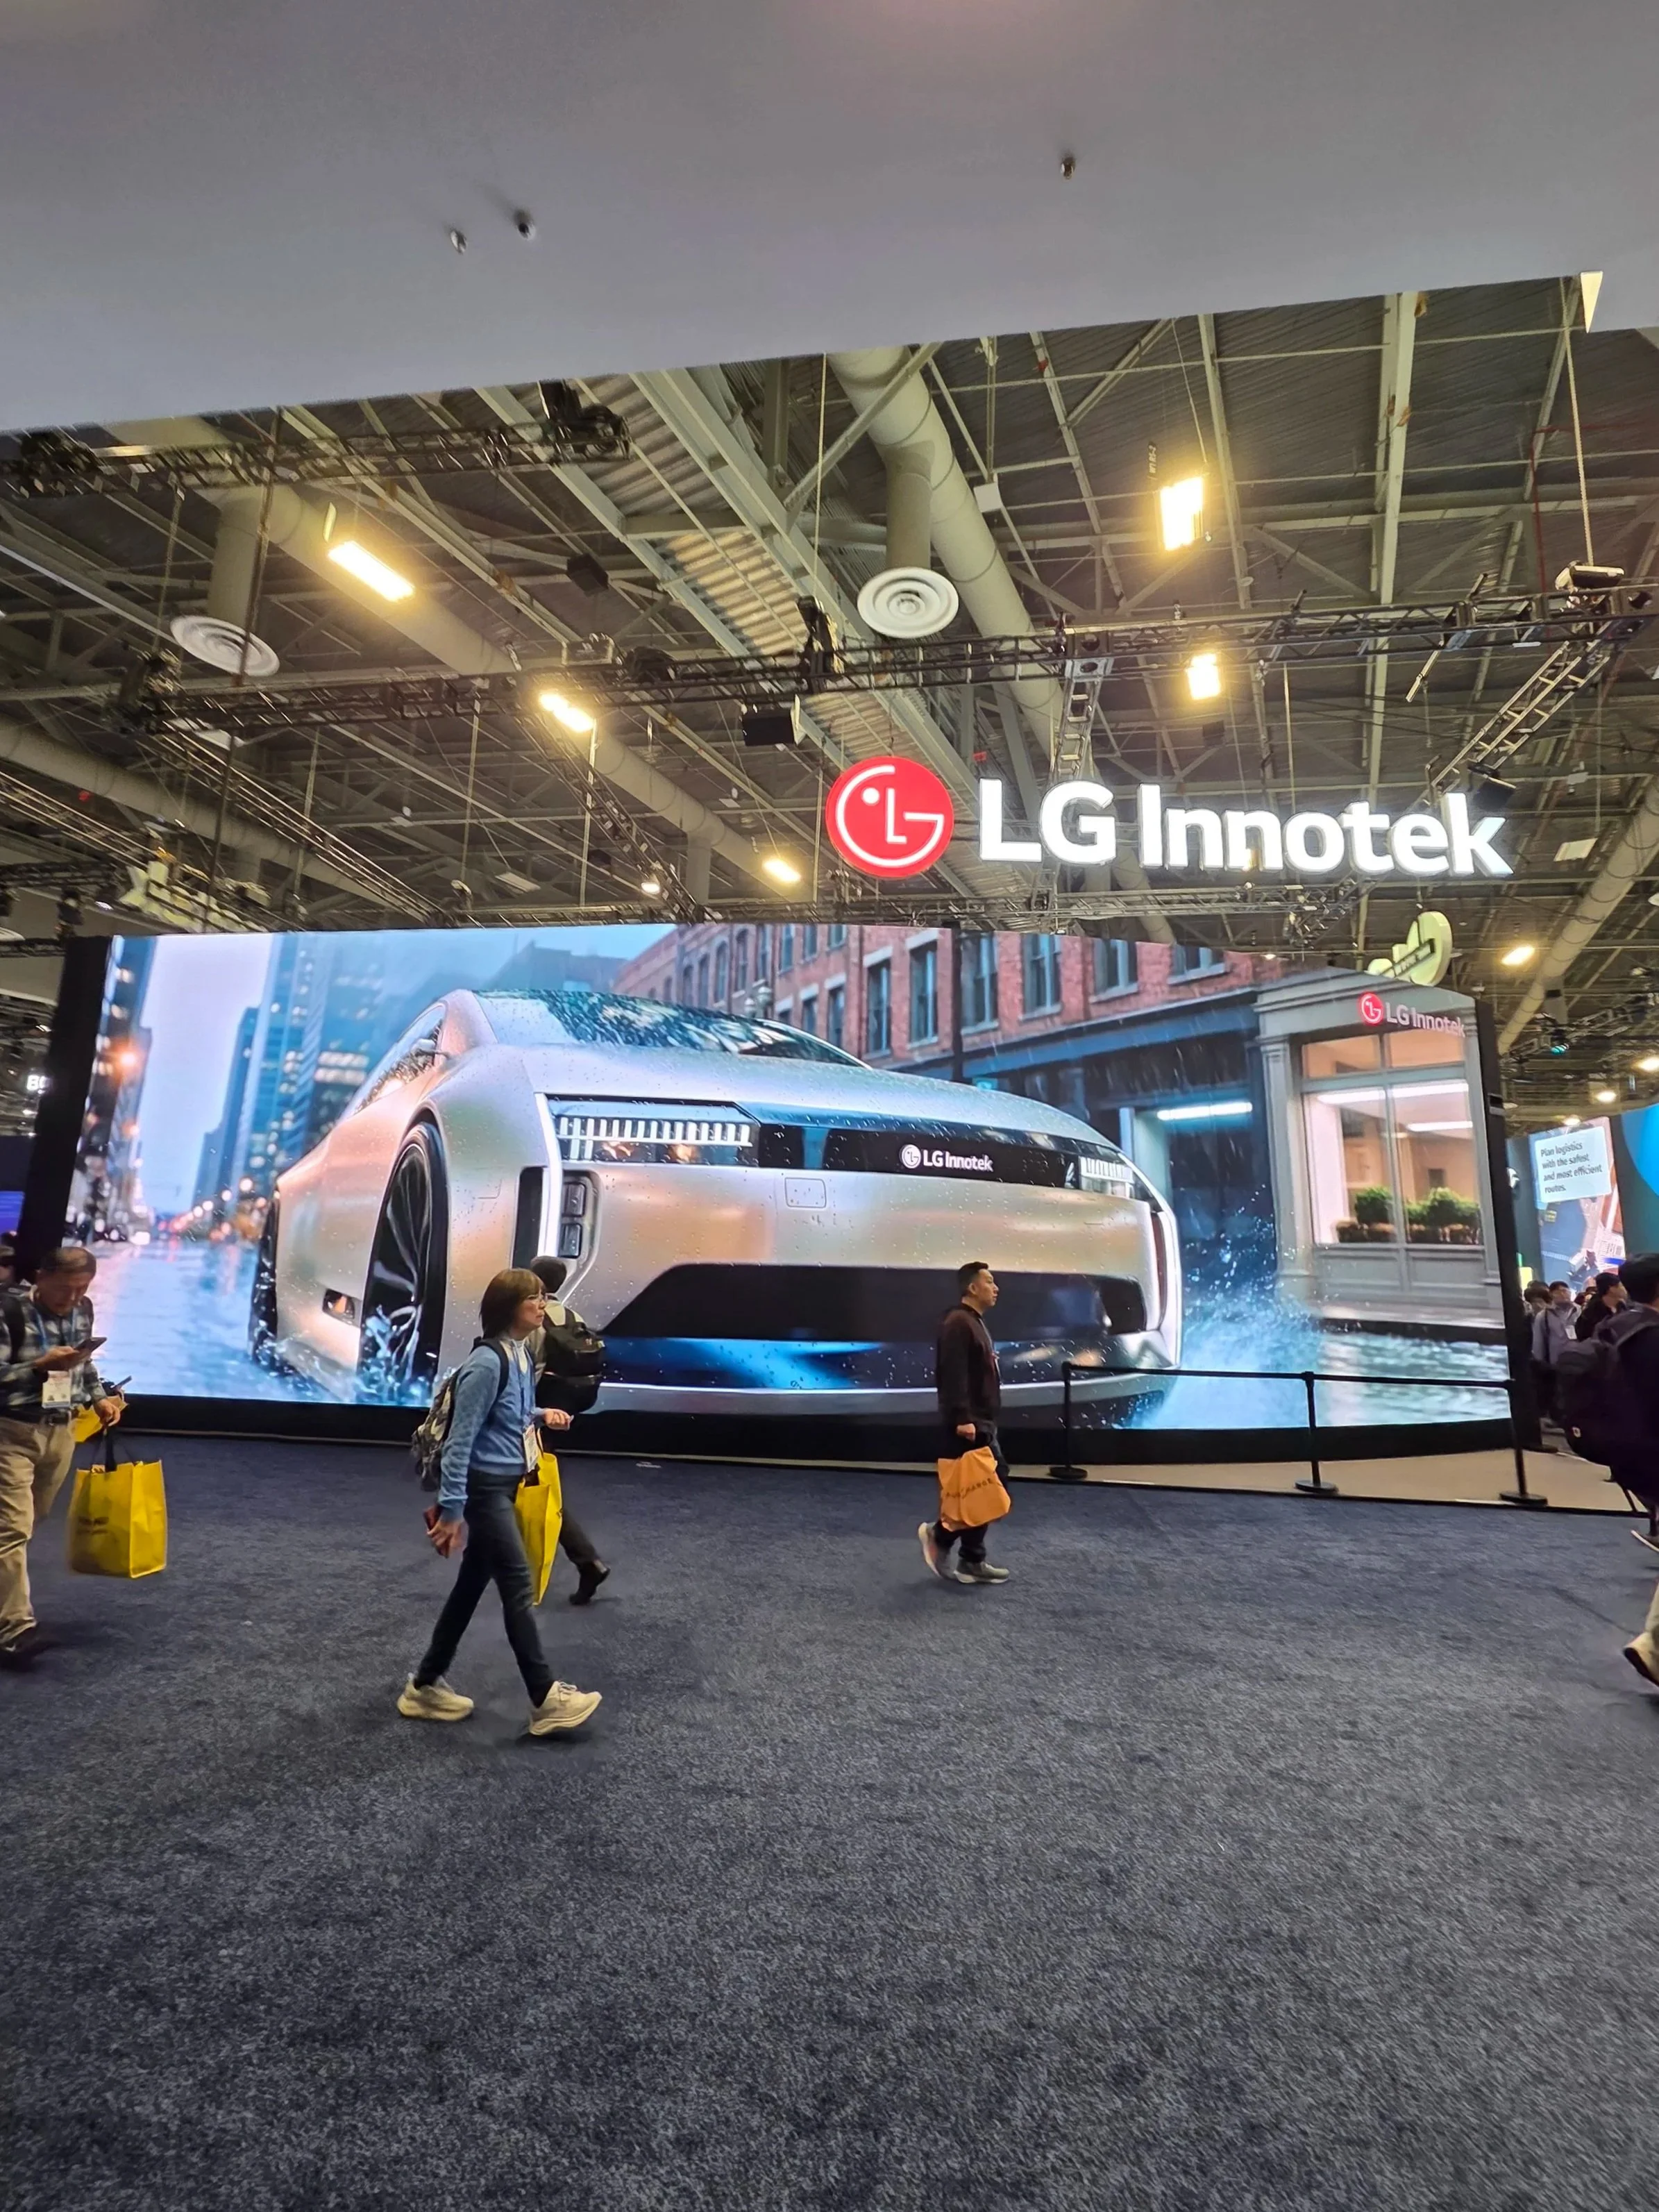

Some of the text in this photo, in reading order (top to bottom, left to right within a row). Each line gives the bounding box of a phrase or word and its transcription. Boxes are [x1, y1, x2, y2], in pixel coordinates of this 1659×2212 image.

[978, 778, 1115, 867] LG
[1138, 782, 1513, 875] Innotek
[1386, 1002, 1410, 1026] LG
[1410, 1007, 1465, 1038] Innotek
[1540, 1141, 1583, 1157] Plan logistics
[923, 1150, 943, 1167] LG
[945, 1150, 993, 1171] Innotek
[1542, 1153, 1590, 1169] with the safest
[1544, 1164, 1602, 1181] and most efficient
